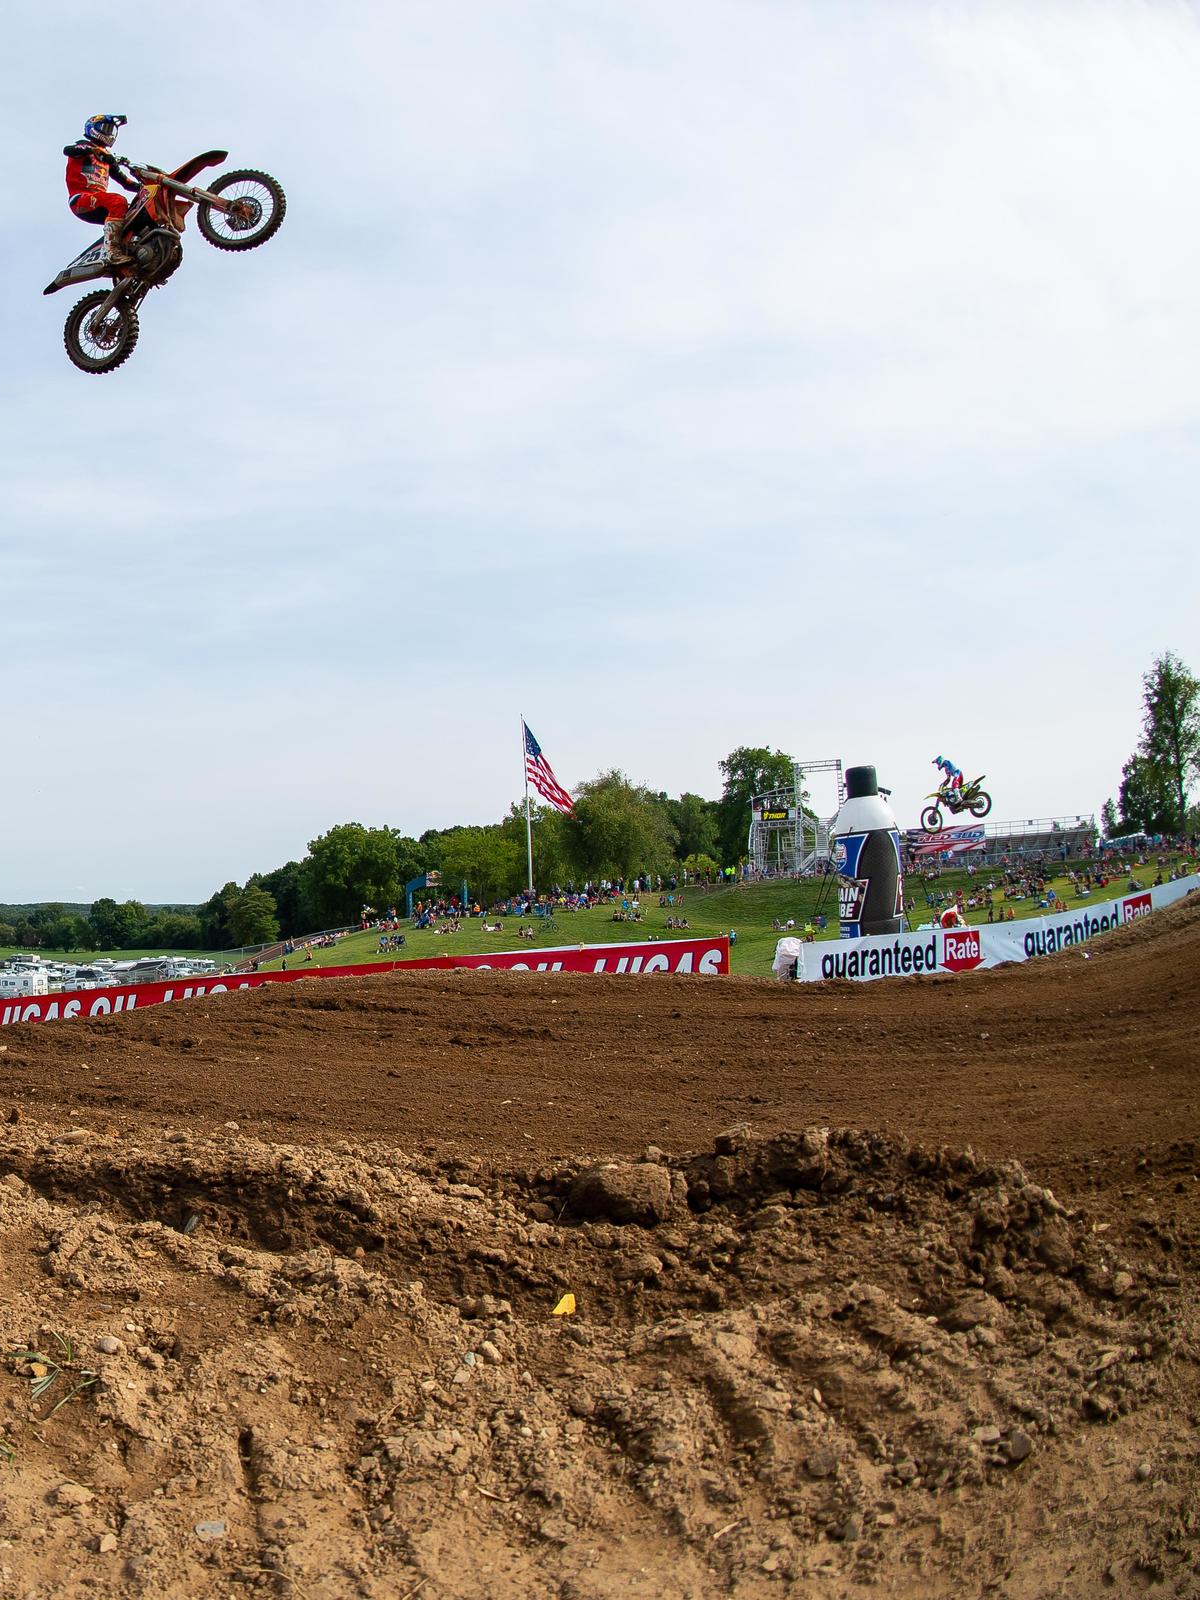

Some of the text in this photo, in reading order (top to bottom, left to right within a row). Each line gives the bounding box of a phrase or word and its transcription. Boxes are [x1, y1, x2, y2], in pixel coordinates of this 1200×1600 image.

[838, 887, 859, 902] AIN
[839, 903, 855, 918] BE
[1124, 901, 1151, 922] Rate
[822, 935, 980, 980] guaranteed Rate
